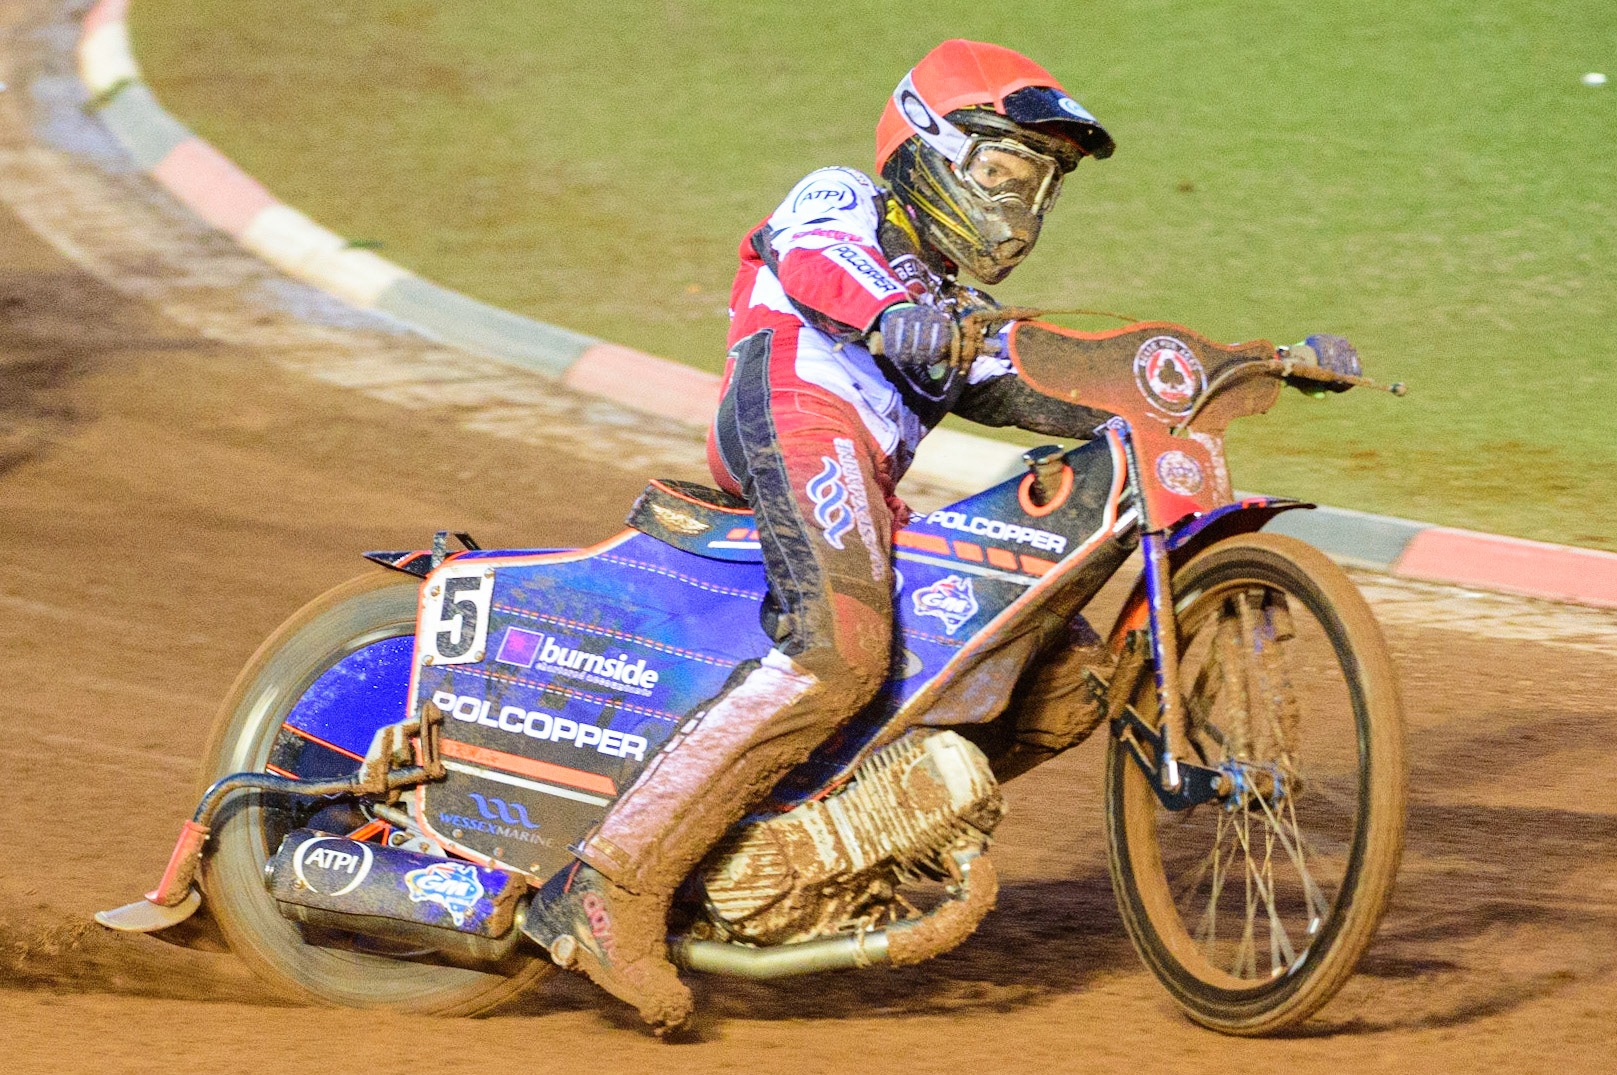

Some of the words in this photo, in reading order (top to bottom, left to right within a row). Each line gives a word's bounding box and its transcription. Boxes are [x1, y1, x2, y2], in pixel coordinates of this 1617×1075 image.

[800, 190, 846, 205] ATPI
[832, 246, 897, 292] POLCOPPER
[926, 510, 1067, 554] POLCOPPER
[436, 576, 481, 658] 5
[539, 637, 659, 689] burnside
[432, 690, 648, 762] POLCOPPER
[304, 847, 359, 874] ATPI
